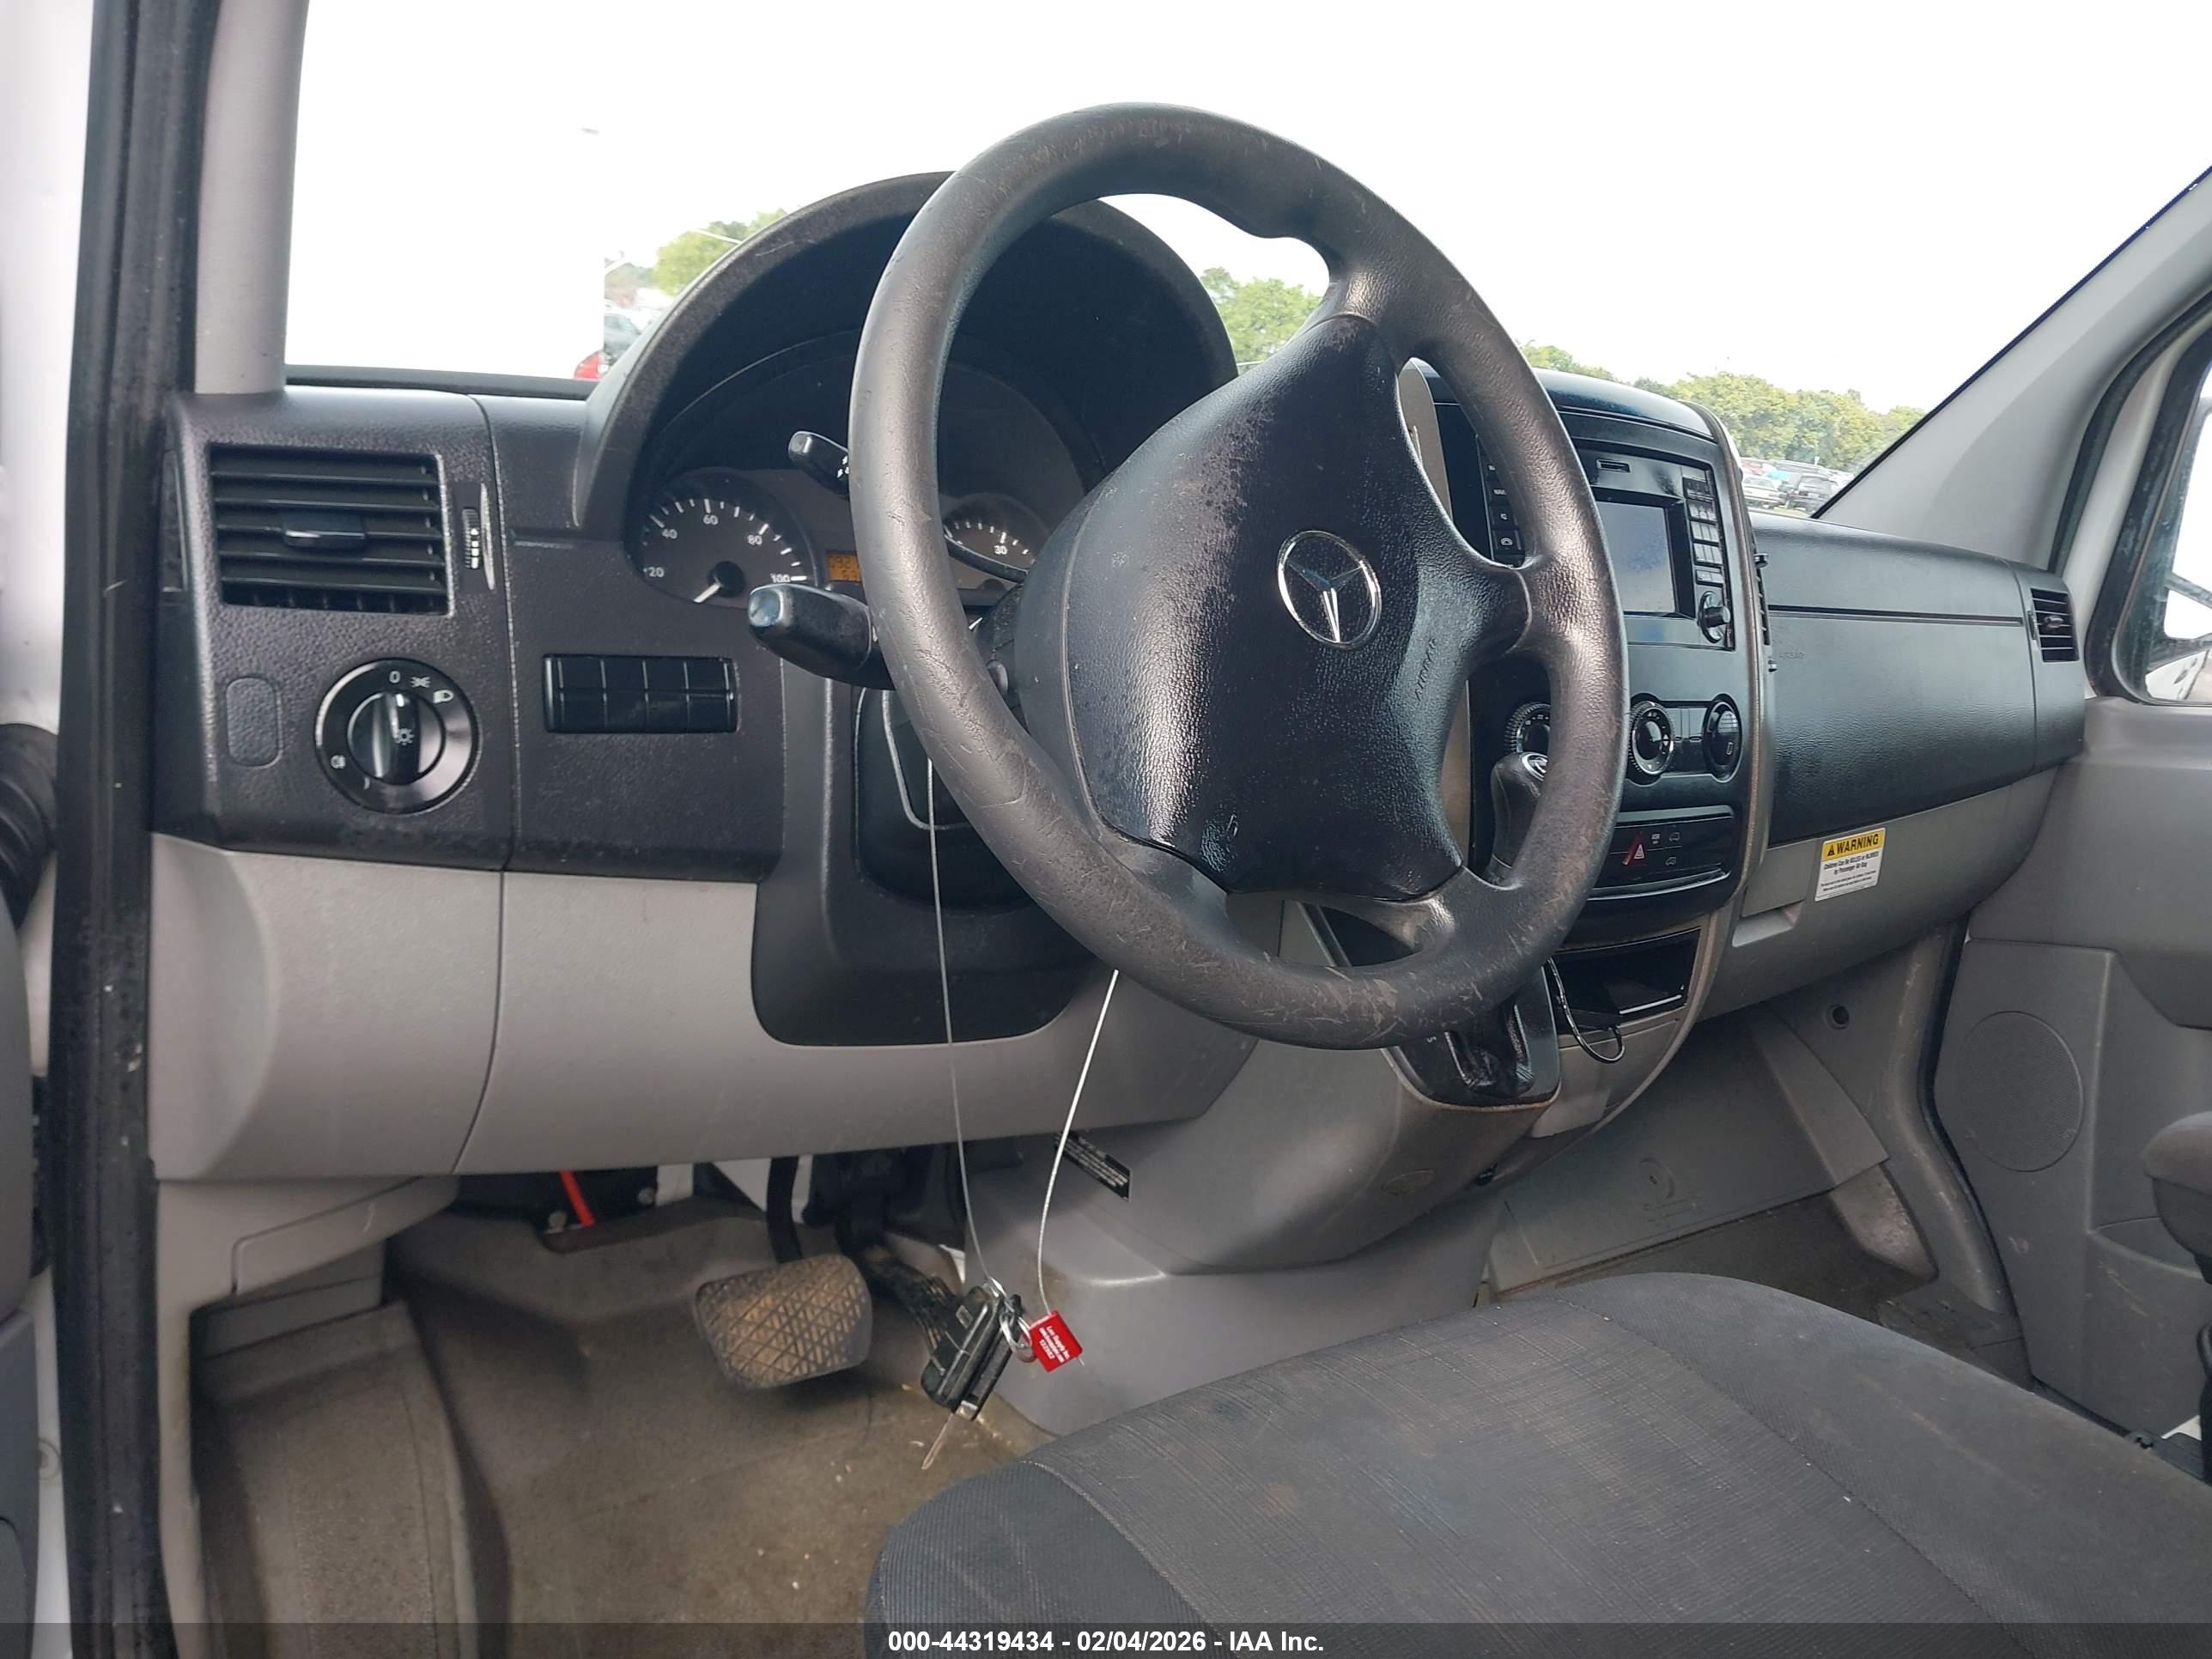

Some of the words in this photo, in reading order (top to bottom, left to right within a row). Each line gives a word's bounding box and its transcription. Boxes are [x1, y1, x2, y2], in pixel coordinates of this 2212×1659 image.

[703, 515, 719, 526] 60
[662, 528, 678, 539] 40
[748, 534, 763, 545] 80
[994, 545, 1007, 556] 30
[648, 567, 665, 577] 20
[770, 573, 790, 583] 100
[1837, 834, 1879, 854] WARNING
